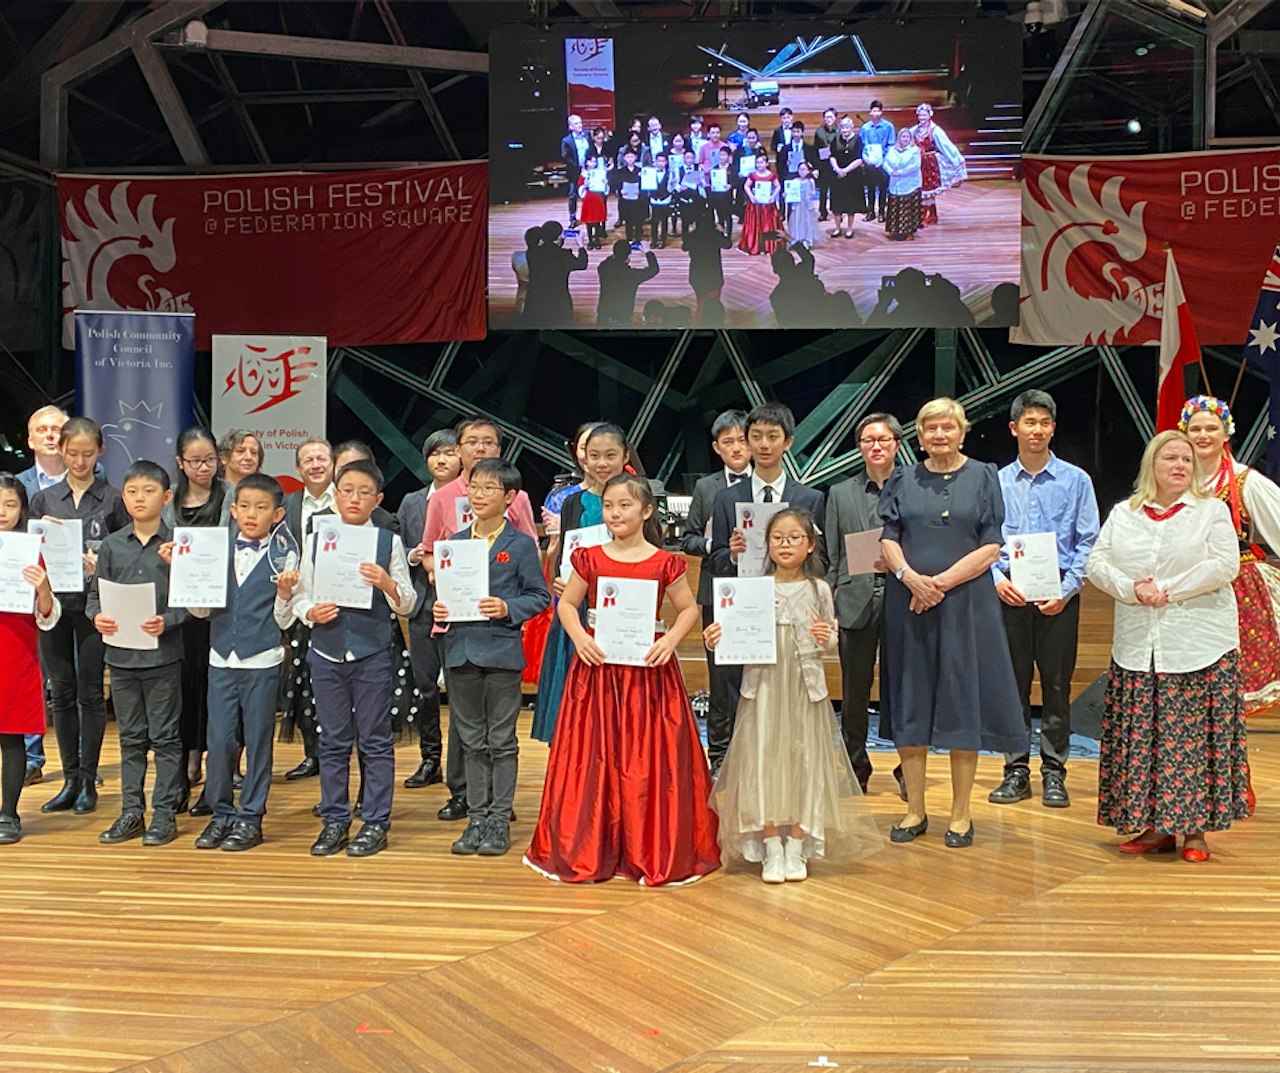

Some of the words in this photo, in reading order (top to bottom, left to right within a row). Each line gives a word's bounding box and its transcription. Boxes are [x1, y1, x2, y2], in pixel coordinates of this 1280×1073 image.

[203, 185, 314, 213] POLISH
[328, 176, 473, 208] FESTIVAL
[224, 211, 373, 234] FEDERATION
[382, 204, 473, 229] SQUARE
[88, 328, 121, 339] Polish
[123, 329, 183, 343] Community
[113, 344, 153, 354] Council
[95, 357, 107, 367] of
[109, 358, 151, 368] Victoria
[154, 359, 174, 369] Inc.
[267, 429, 277, 437] of
[279, 429, 309, 438] Polish
[263, 442, 272, 450] in
[275, 441, 299, 450] Victo
